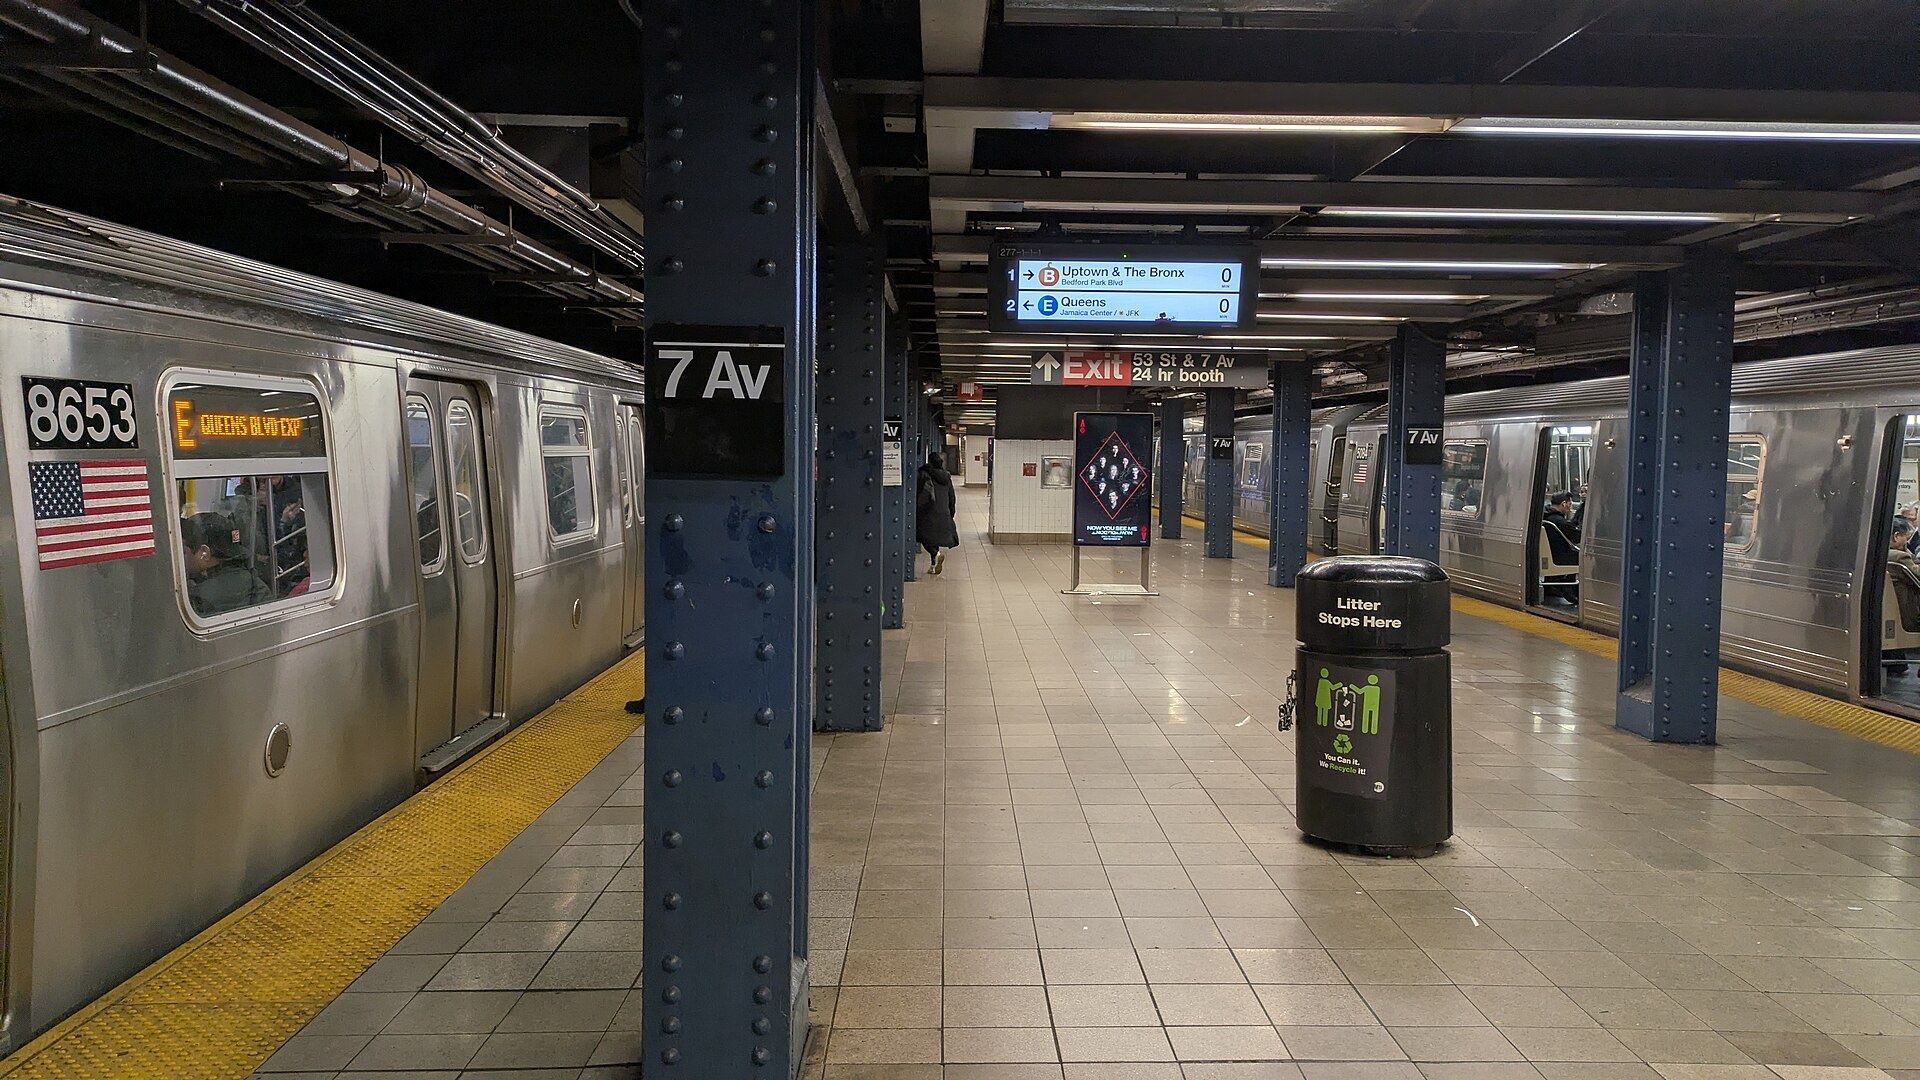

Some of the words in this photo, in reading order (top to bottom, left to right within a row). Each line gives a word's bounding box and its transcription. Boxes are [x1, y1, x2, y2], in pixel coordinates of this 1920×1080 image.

[1008, 269, 1015, 280] 1
[1043, 269, 1055, 282] B
[1062, 266, 1108, 278] Uptown
[1112, 267, 1120, 276] &
[1124, 267, 1146, 277] The
[1149, 267, 1185, 277] Bronx
[1221, 268, 1232, 283] 0
[1007, 300, 1016, 311] 2
[1043, 300, 1053, 311] E
[1061, 296, 1106, 307] Queens
[1219, 298, 1230, 313] 0
[1063, 352, 1123, 379] Exit
[1132, 353, 1153, 367] 53
[1160, 353, 1177, 367] St
[1183, 353, 1195, 367] &
[1200, 354, 1211, 367] 7
[1216, 354, 1235, 367] Av
[658, 350, 694, 397] 7
[702, 351, 771, 399] Av
[1132, 367, 1152, 381] 24
[1158, 367, 1174, 382] hr
[1180, 368, 1224, 382] booth
[28, 384, 136, 442] 8653
[175, 400, 195, 446] E
[201, 414, 248, 436] QUEENS
[249, 416, 278, 436] BLVD
[280, 417, 300, 436] EXP
[883, 422, 899, 437] Av
[1213, 439, 1220, 447] 7
[1220, 439, 1231, 447] Av
[1408, 430, 1419, 443] 7
[1420, 430, 1439, 444] Av
[1337, 597, 1381, 611] Litter
[1318, 612, 1360, 628] Stops
[1363, 615, 1402, 629] Here
[1324, 752, 1336, 761] You
[1337, 756, 1351, 764] Can
[1352, 758, 1361, 766] it.
[1319, 760, 1329, 768] We
[1329, 763, 1357, 774] Recycle
[1358, 767, 1366, 775] it!
